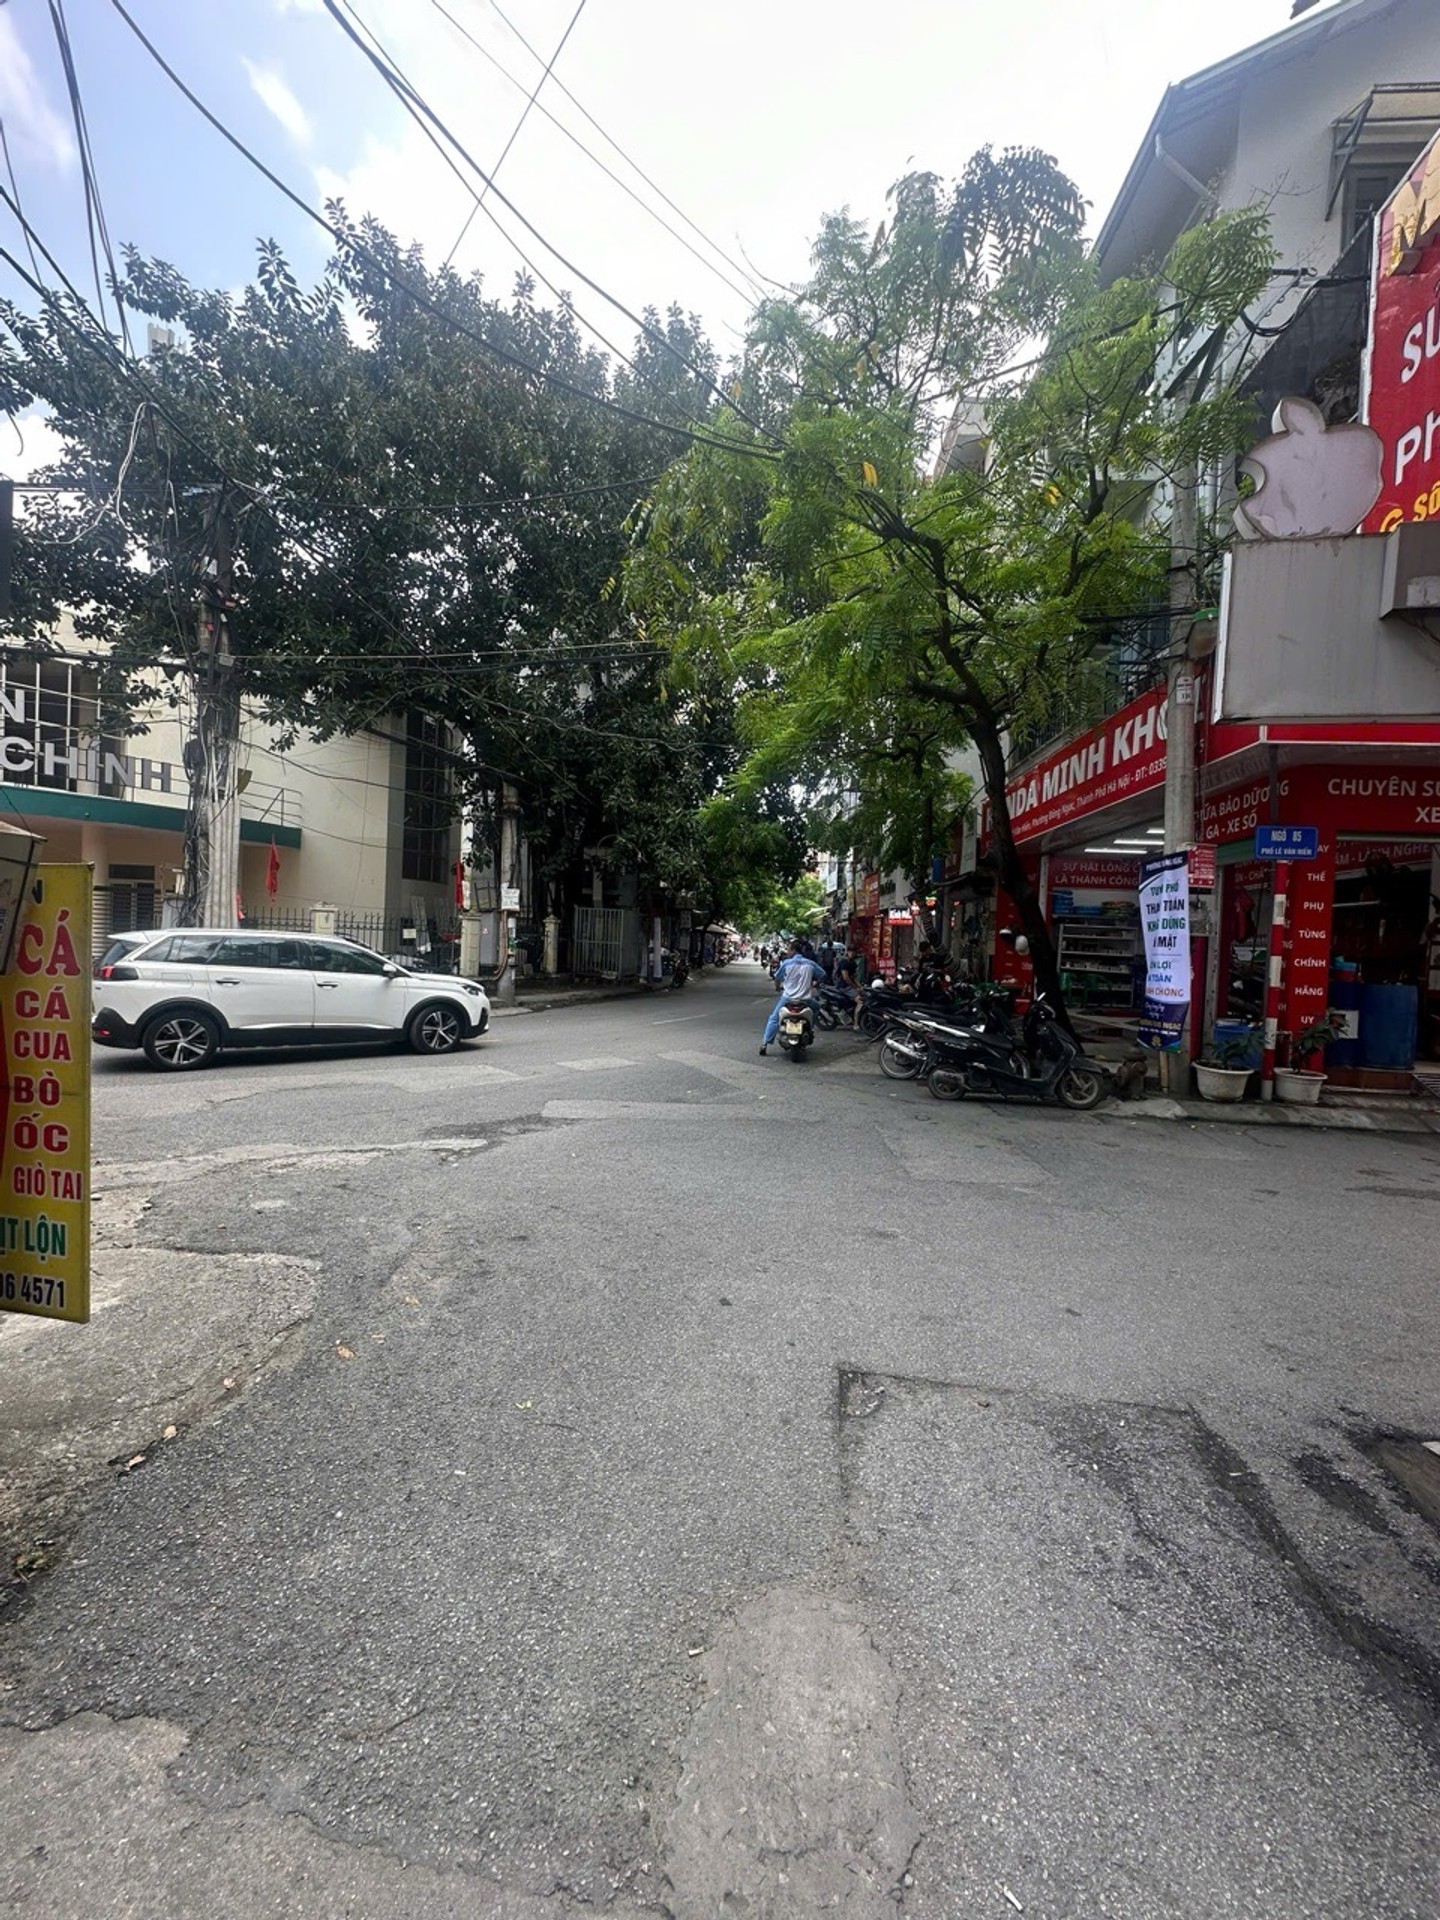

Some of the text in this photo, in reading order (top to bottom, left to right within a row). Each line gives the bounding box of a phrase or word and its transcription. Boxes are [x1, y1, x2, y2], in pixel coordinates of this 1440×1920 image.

[0, 737, 172, 792] CHÍNH
[1043, 737, 1106, 802] MINH
[1327, 776, 1416, 797] CHUYÊN
[1205, 806, 1257, 839] GA XE SỐ
[1415, 806, 1440, 823] XE
[1292, 831, 1302, 842] 85
[1261, 846, 1274, 855] PHỐ
[1317, 844, 1329, 853] AY
[1101, 862, 1130, 873] LÒNG
[1055, 873, 1138, 886] LÀ THÀNH CÔNG
[1303, 902, 1325, 911] PHỤ
[17, 909, 81, 976] CÁ
[1299, 929, 1326, 939] TÙNG
[1294, 956, 1326, 968] CHÍNH
[1295, 984, 1324, 996] HÃNG
[15, 986, 71, 1019] CÁ
[1301, 1015, 1315, 1024] UY
[14, 1031, 71, 1060] CUA
[14, 1070, 60, 1106] BÒ
[14, 1113, 68, 1152] ỐC
[14, 1162, 82, 1200] GIÒ TAI
[0, 1214, 65, 1261] ỊT LỘN
[21, 1275, 64, 1308] 4571
